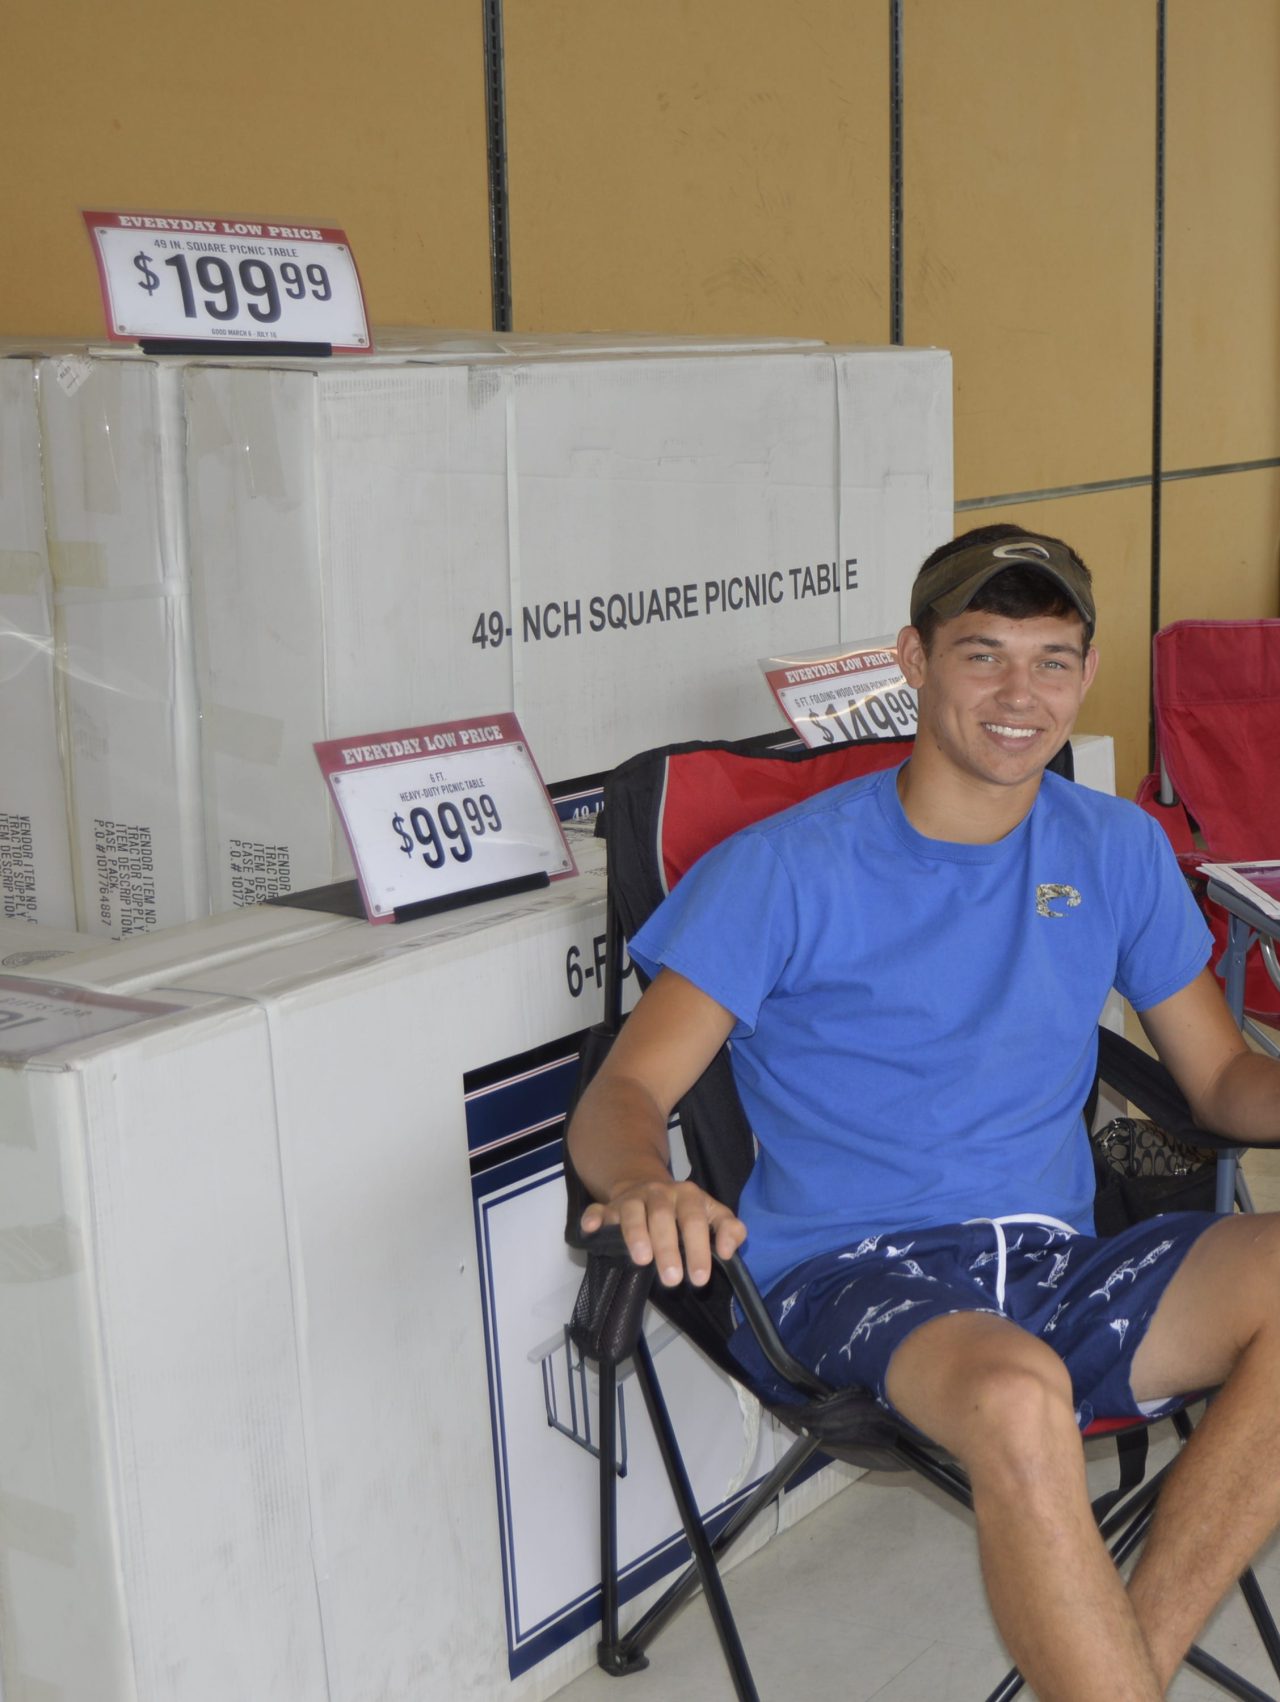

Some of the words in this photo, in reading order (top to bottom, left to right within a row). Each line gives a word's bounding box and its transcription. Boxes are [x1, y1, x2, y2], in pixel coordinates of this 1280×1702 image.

[118, 215, 216, 233] EVERYDAY
[222, 222, 263, 237] LOW
[269, 225, 323, 241] PRICE
[154, 239, 168, 249] 49
[170, 240, 185, 250] IN.
[187, 241, 226, 254] SQUARE
[230, 244, 266, 256] PICNIC
[269, 246, 299, 258] TABLE
[589, 583, 699, 634] SQUARE
[704, 571, 784, 616] PICNIC
[788, 558, 859, 600] TABLE
[785, 661, 840, 684] EVERYDAY
[839, 658, 863, 672] LOW
[863, 651, 895, 667] PRICE
[810, 690, 836, 704] FOLDING
[836, 686, 854, 698] WOOD
[854, 682, 871, 694] GRAIN
[342, 738, 421, 766] EVERYDAY
[424, 731, 457, 751] LOW
[459, 725, 503, 746] PRICE
[400, 785, 441, 802] HEAVY-DUTY
[441, 781, 465, 796] PICNIC
[465, 777, 486, 792] TABLE
[429, 773, 435, 783] 6
[436, 771, 447, 782] FT.
[0, 813, 10, 840] ITEM
[9, 815, 23, 867] TRACTOR
[19, 816, 33, 859] VENDOR
[104, 821, 116, 853] CASE
[116, 824, 128, 852] ITEM
[127, 826, 142, 879] TRACTOR
[139, 826, 153, 872] VENDOR
[242, 842, 254, 873] CASE
[253, 843, 265, 872] ITEM
[24, 863, 36, 891] ITEM
[265, 845, 279, 898] TRACTOR
[277, 846, 291, 892] VENDOR
[13, 871, 27, 918] SUPPLY
[142, 876, 155, 905] ITEM
[131, 884, 144, 932] SUPPLY
